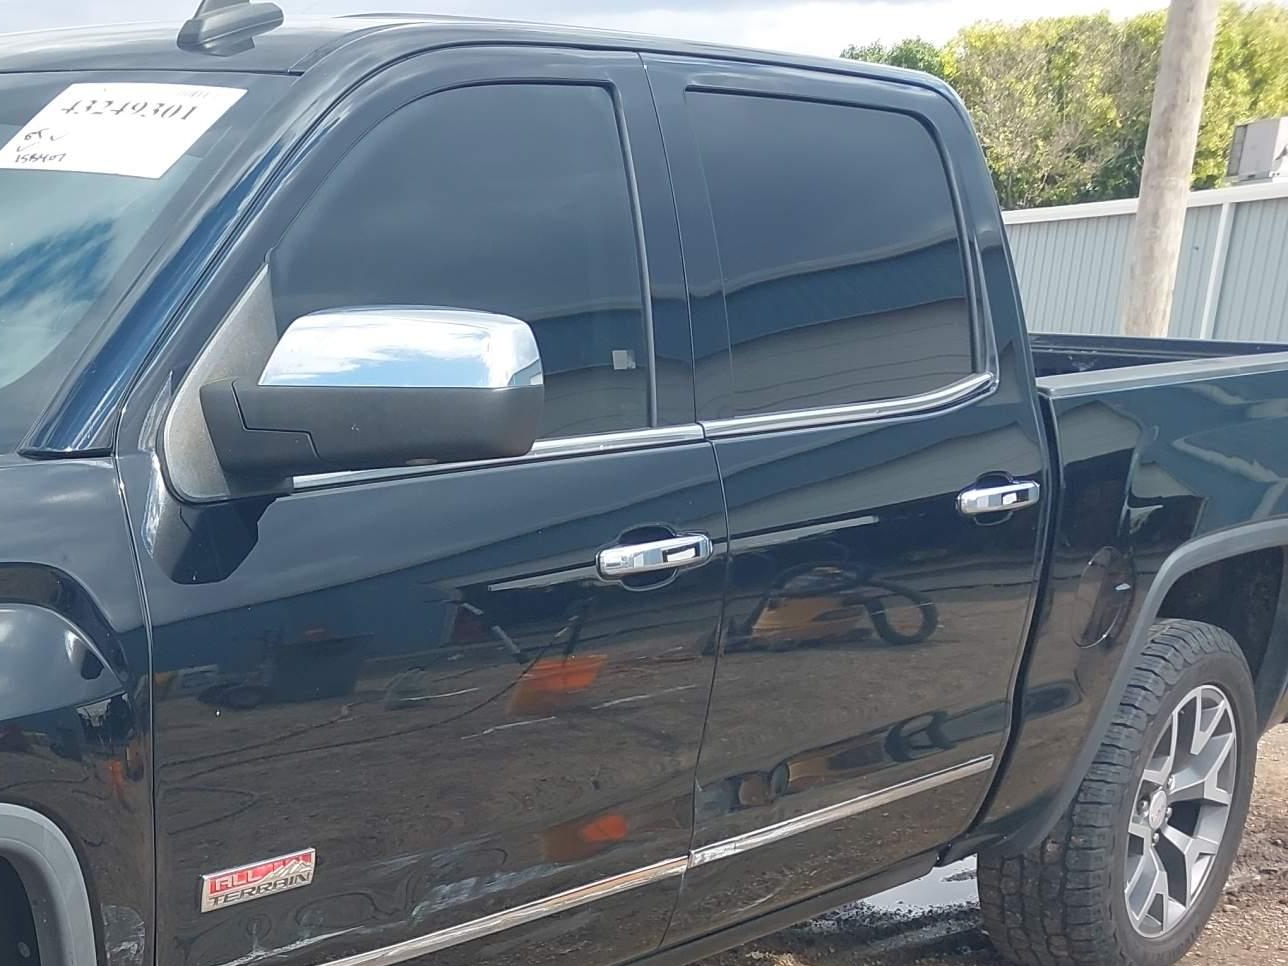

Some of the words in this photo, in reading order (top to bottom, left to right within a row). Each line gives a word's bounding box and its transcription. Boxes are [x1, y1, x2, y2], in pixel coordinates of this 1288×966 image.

[61, 99, 198, 121] 43249301
[209, 871, 311, 907] TERRAIN
[215, 870, 263, 891] ALL
